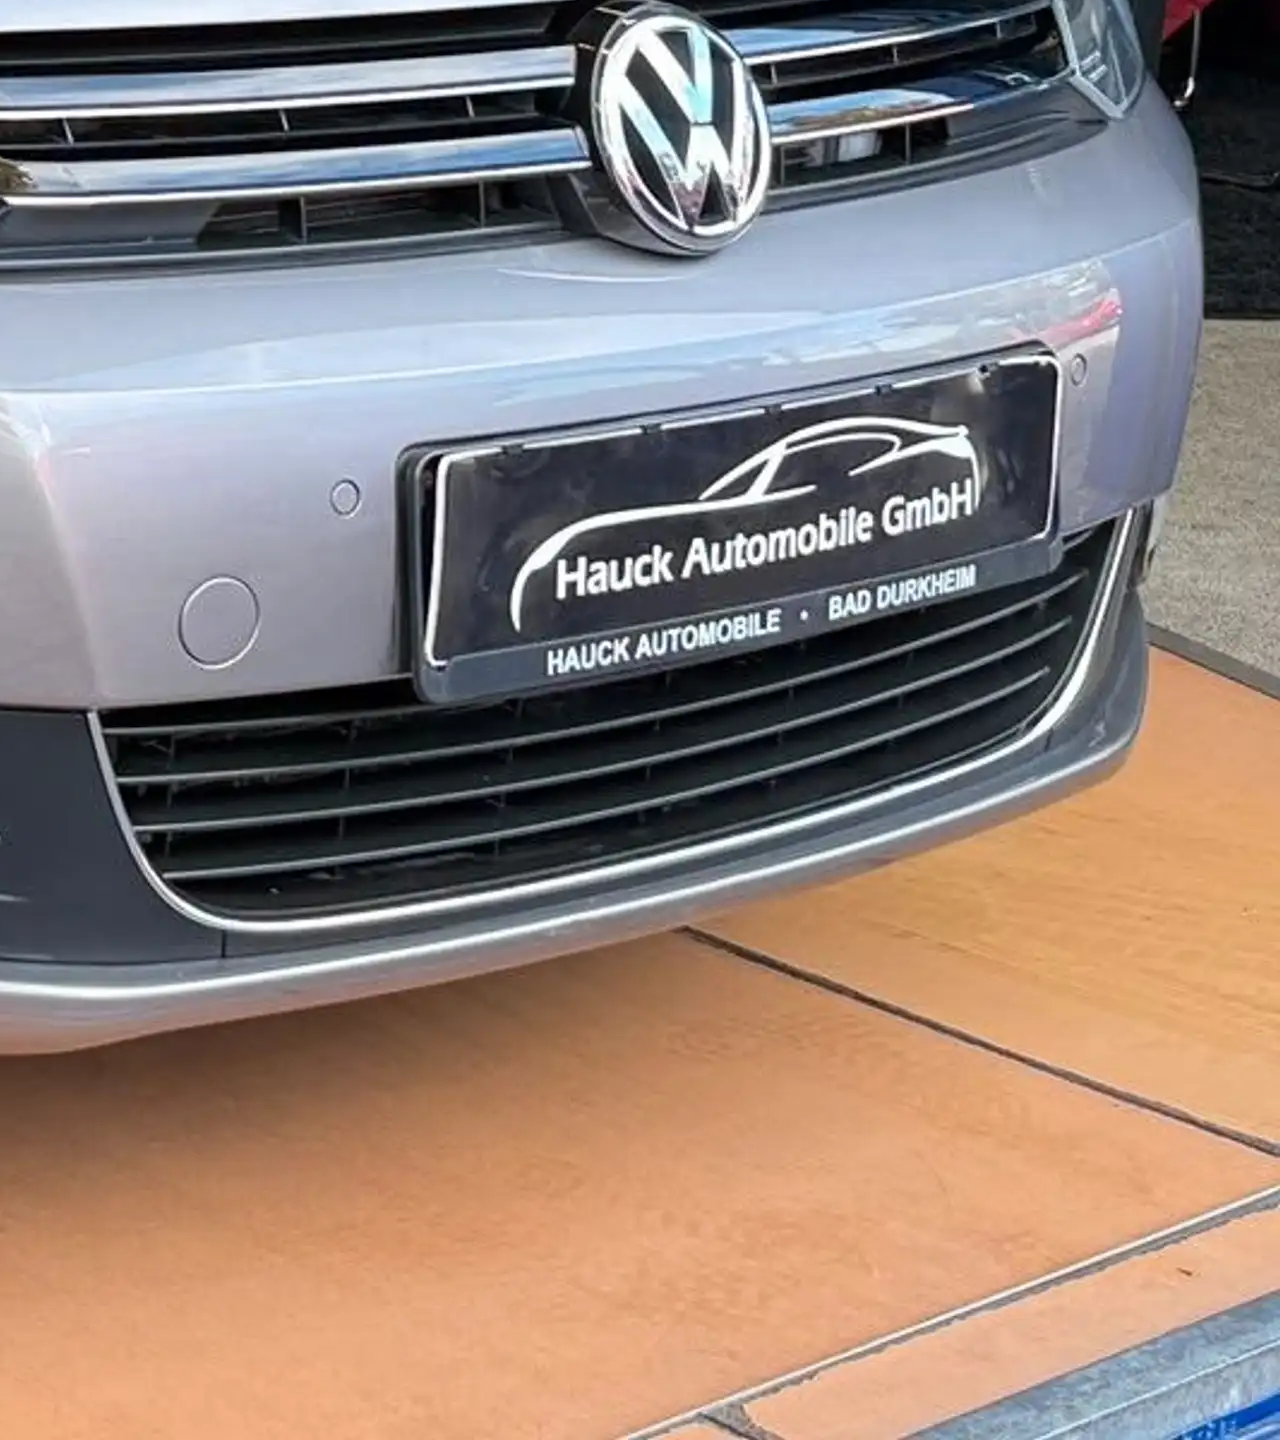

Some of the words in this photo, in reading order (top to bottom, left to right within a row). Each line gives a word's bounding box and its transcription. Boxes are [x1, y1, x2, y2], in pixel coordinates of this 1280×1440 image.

[555, 545, 674, 600] Hauck
[681, 506, 874, 579] Automobile
[881, 478, 973, 537] GmbH
[547, 636, 631, 676] HAUCK
[635, 608, 782, 661] AUTOMOBILE
[828, 589, 872, 621] BAD
[877, 563, 978, 609] DURKHEIM
